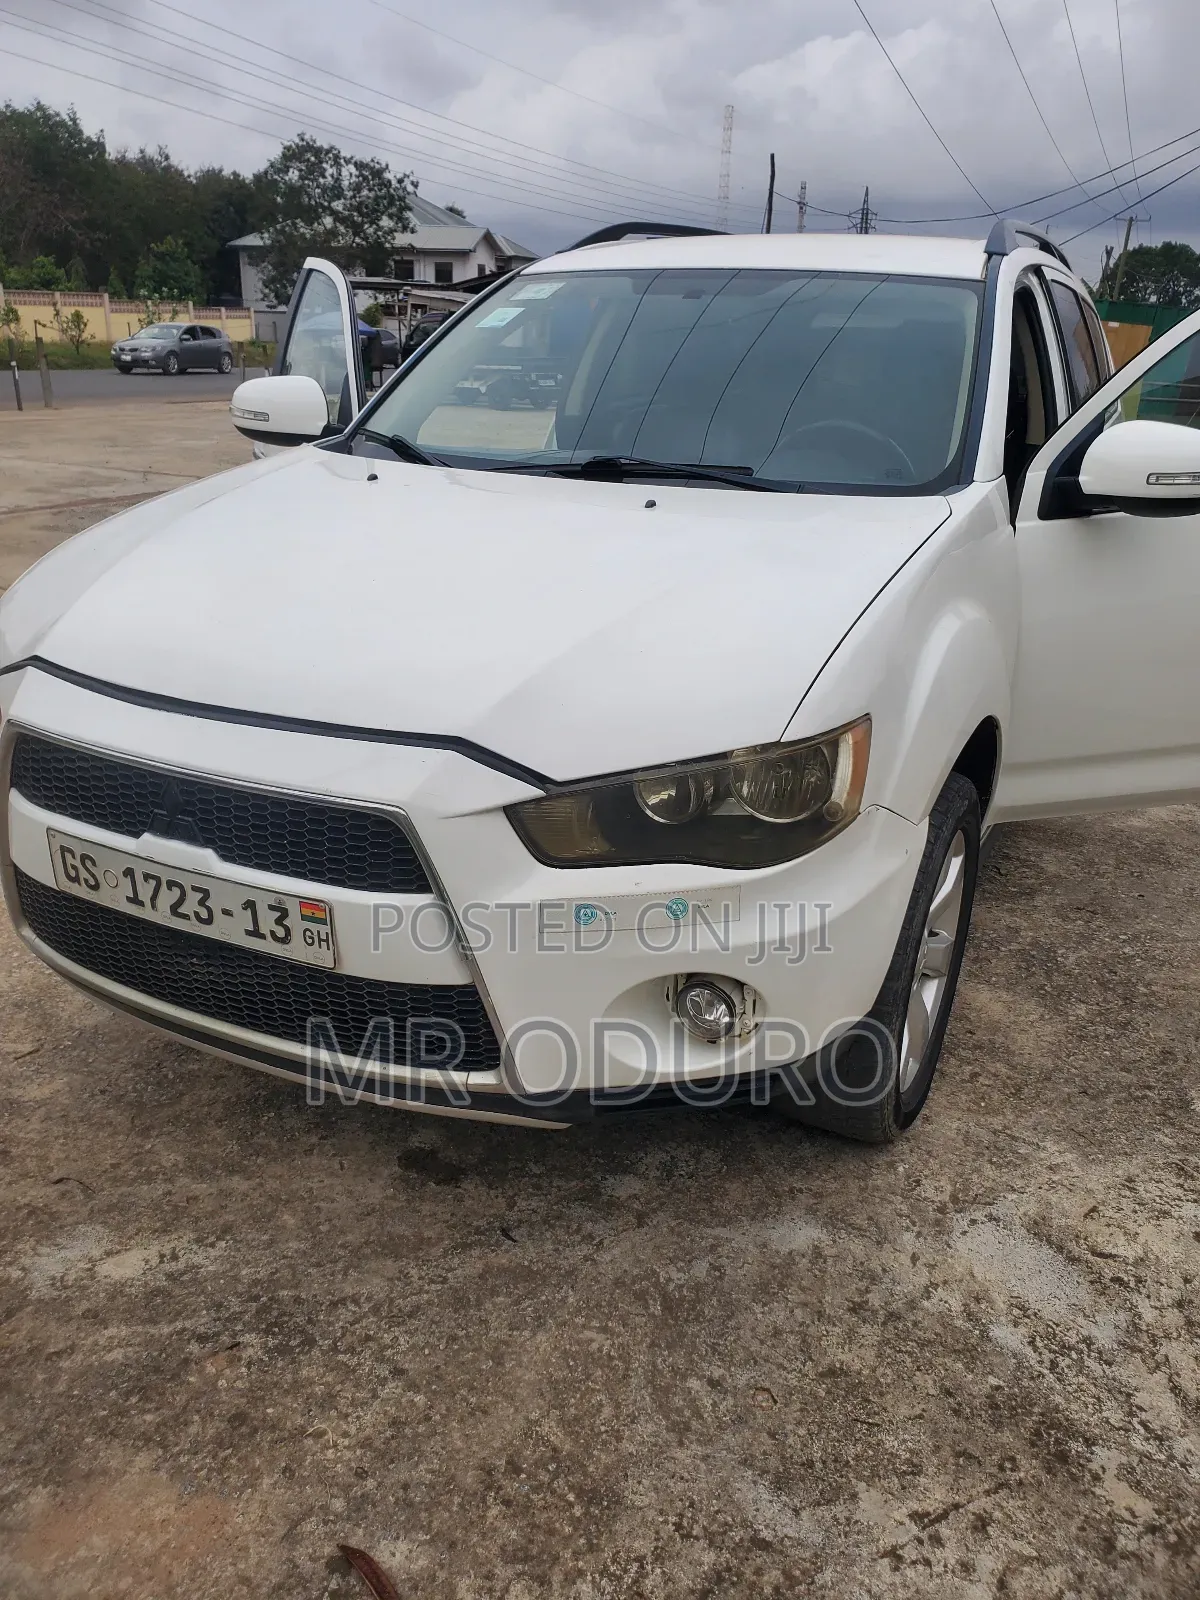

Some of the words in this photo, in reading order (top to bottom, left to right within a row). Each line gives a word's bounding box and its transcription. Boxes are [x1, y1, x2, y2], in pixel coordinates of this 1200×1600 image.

[59, 843, 100, 892] GS
[121, 866, 292, 945] 1723-13
[302, 927, 331, 951] GH
